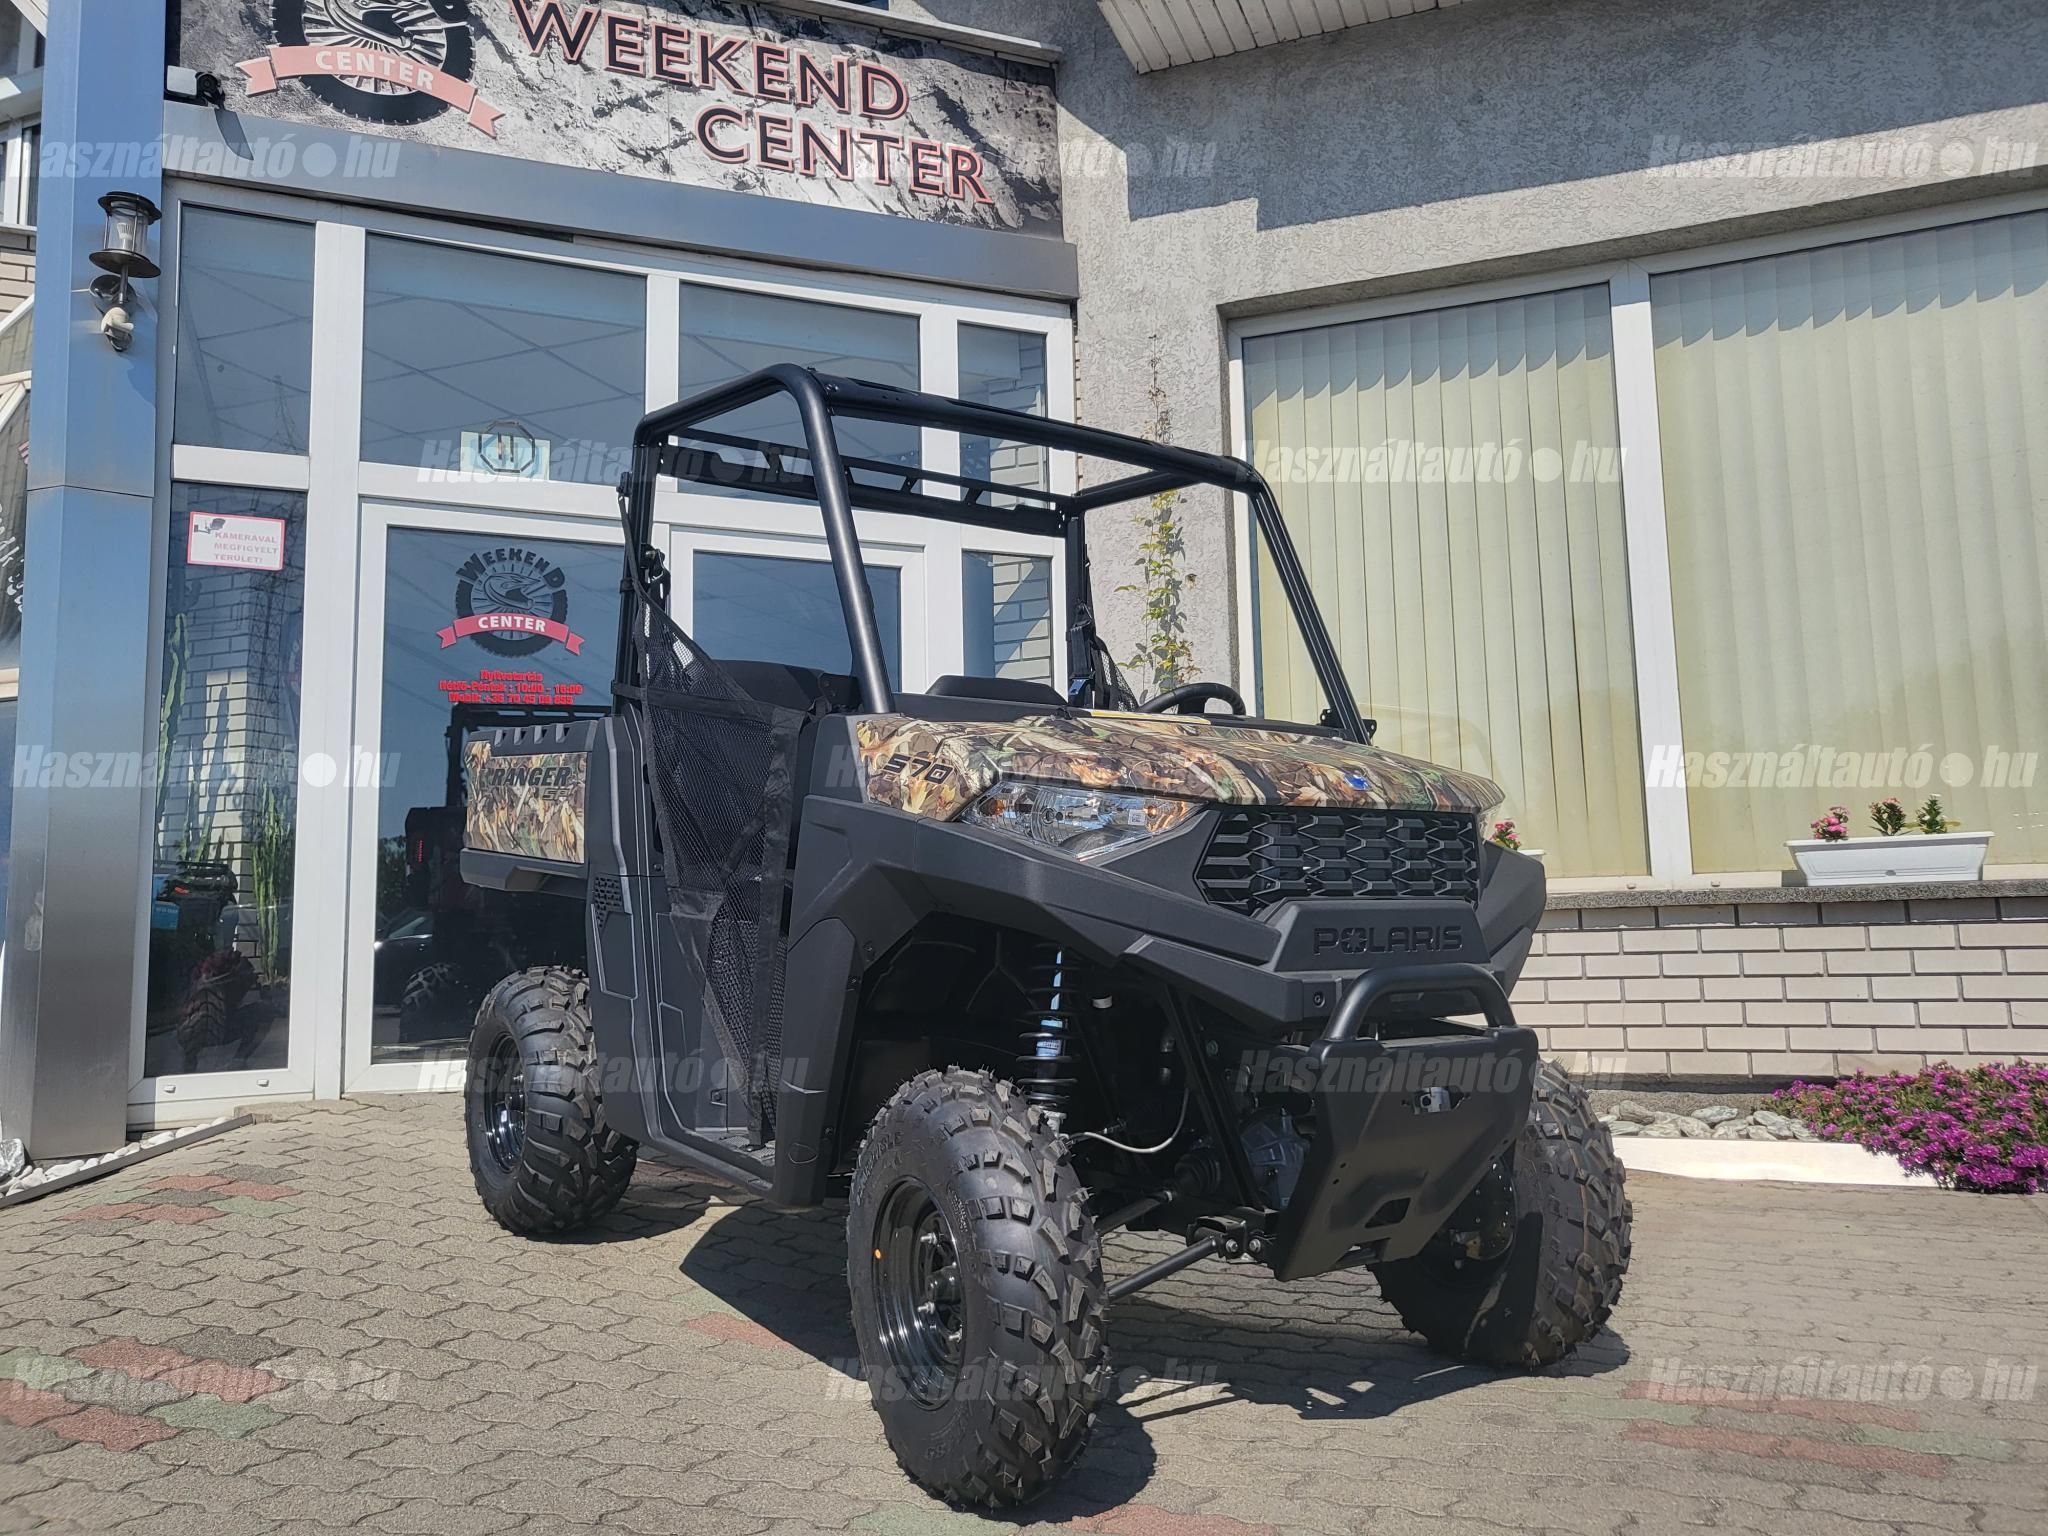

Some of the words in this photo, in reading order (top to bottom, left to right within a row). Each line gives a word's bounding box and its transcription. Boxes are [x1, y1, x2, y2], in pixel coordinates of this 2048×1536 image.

[315, 50, 435, 90] CENTER
[511, 0, 908, 119] WEEKEND
[694, 103, 992, 204] CENTER
[456, 548, 565, 589] WEEKEND
[478, 616, 546, 632] CENTER
[490, 766, 571, 787] RANGER
[881, 752, 955, 785] 570
[1313, 925, 1463, 956] POLARIS
